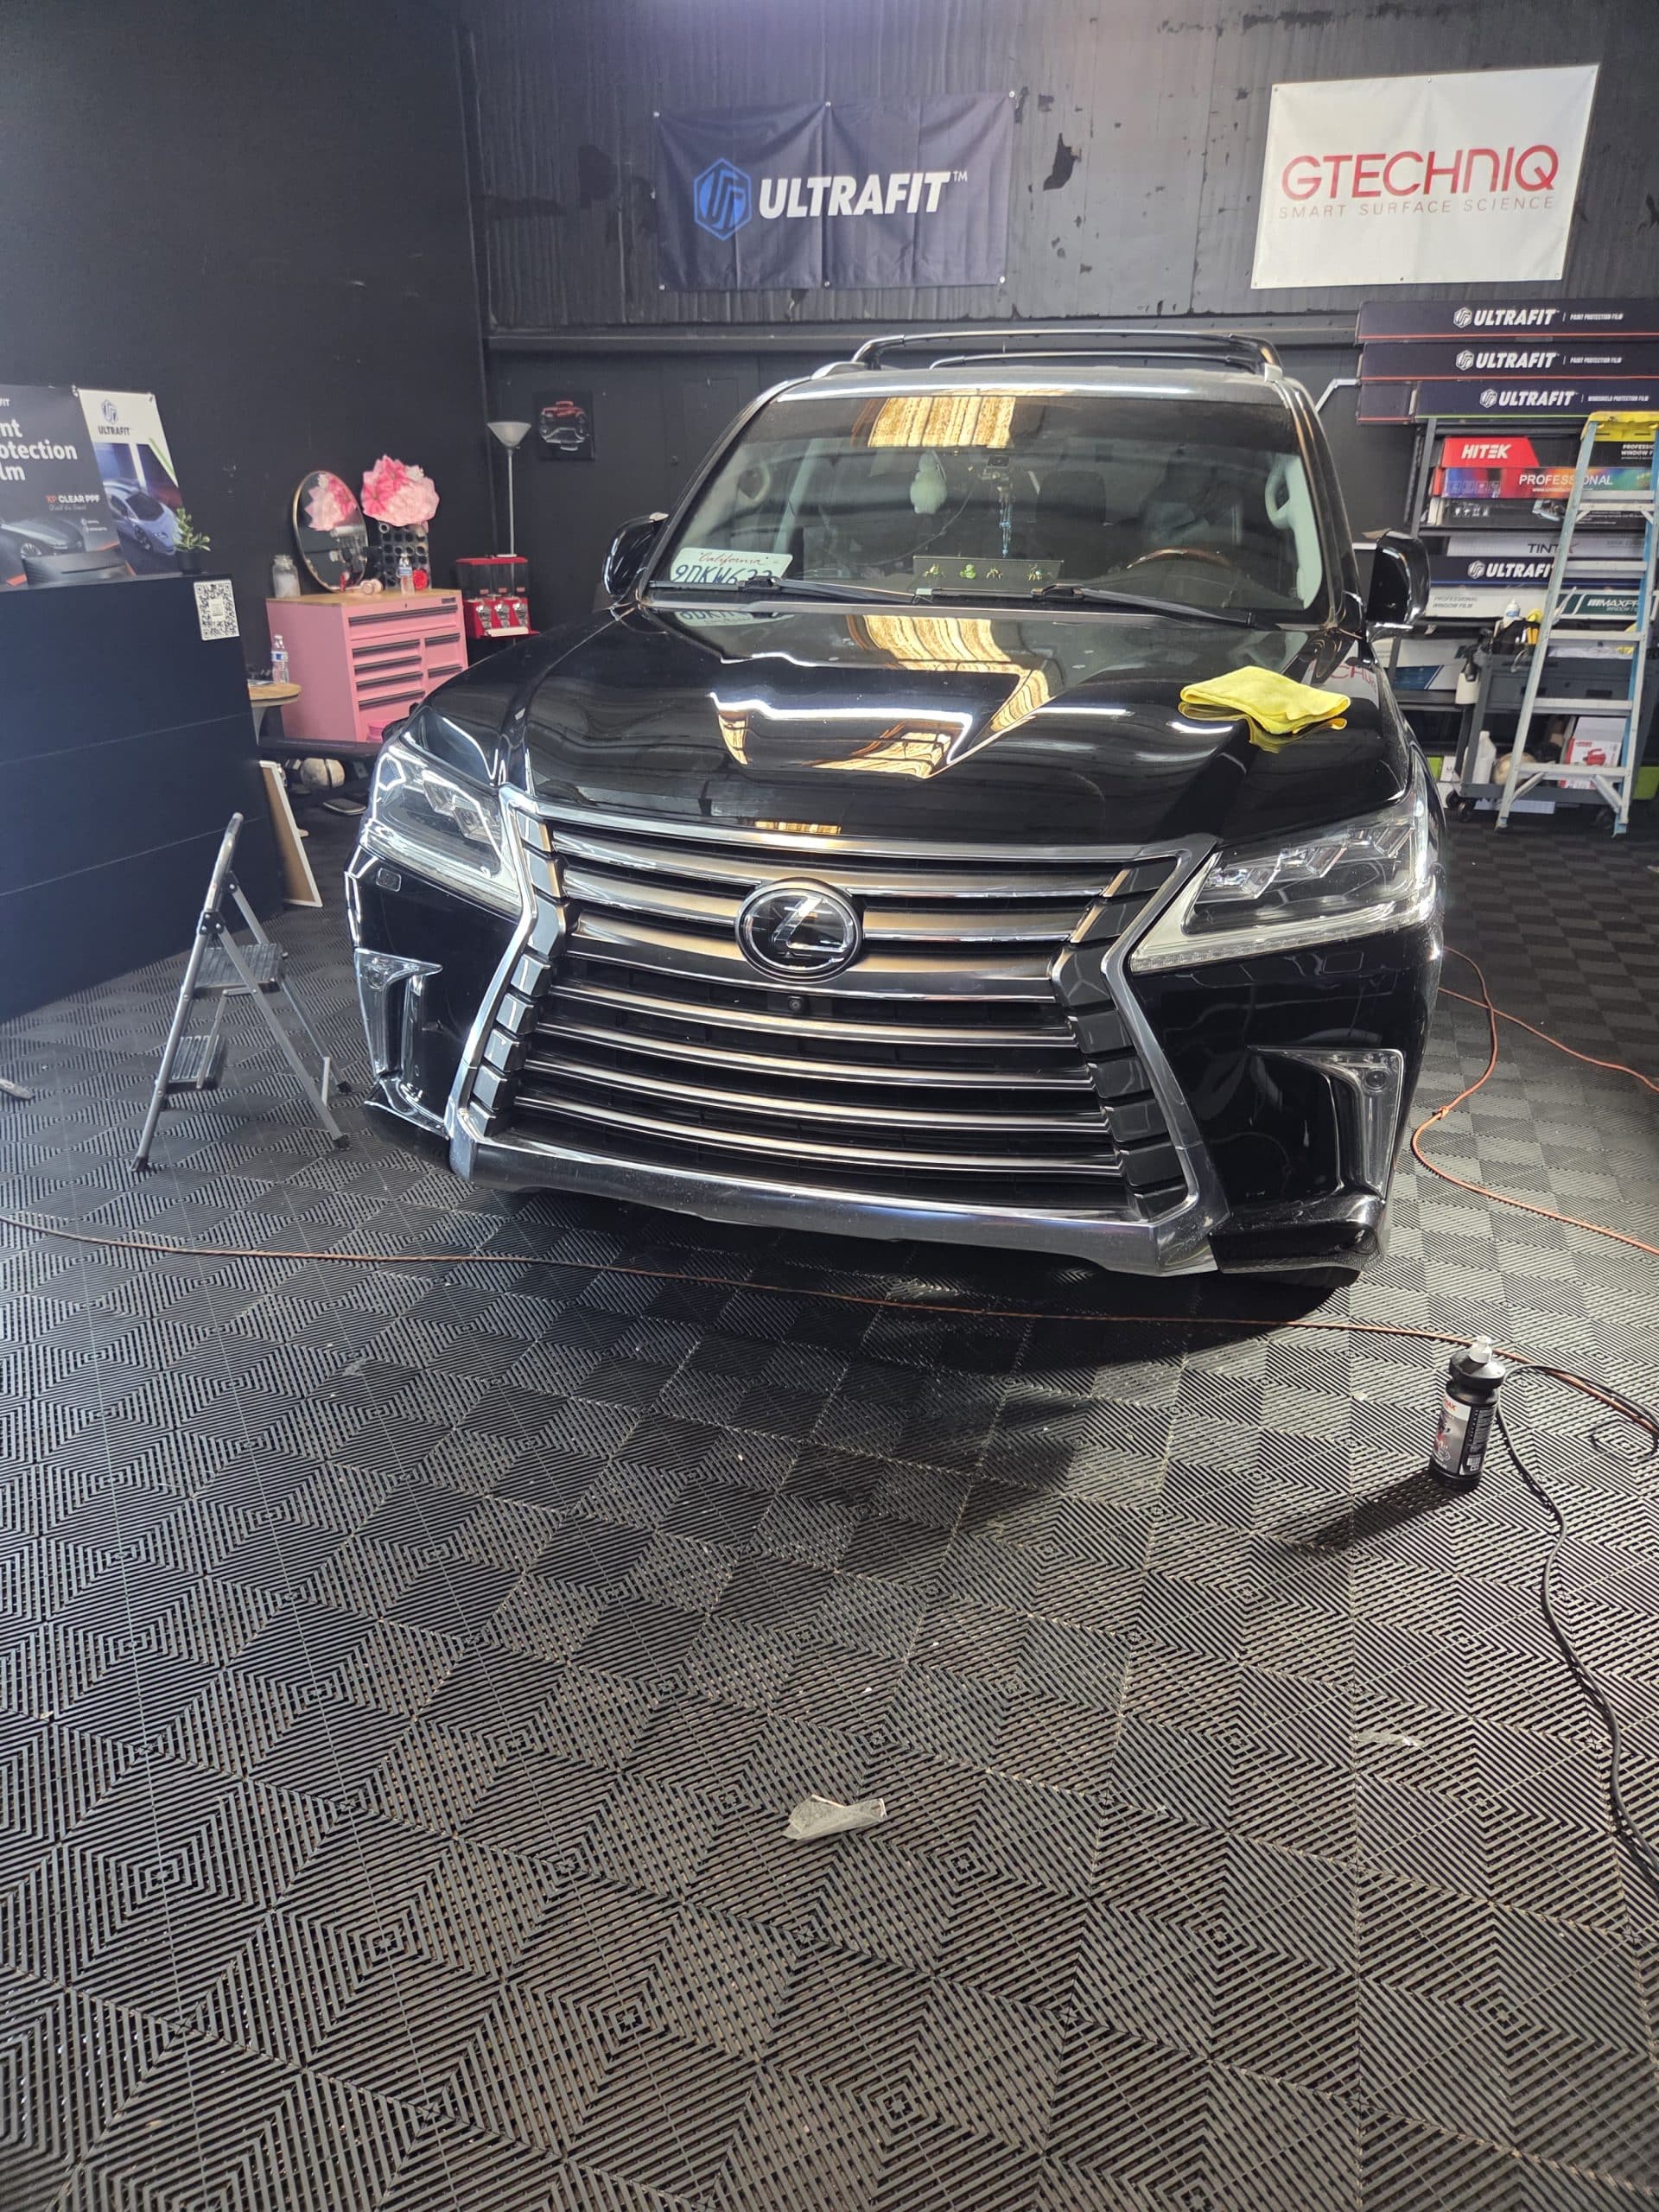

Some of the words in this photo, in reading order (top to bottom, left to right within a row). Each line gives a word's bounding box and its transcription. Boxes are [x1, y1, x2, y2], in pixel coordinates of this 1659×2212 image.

[760, 172, 951, 219] ULTRAFIT
[1279, 204, 1347, 219] SMART
[1359, 200, 1452, 216] SURFACE
[1463, 195, 1554, 213] SCIENCE
[1474, 308, 1556, 327] ULTRAFIT
[1476, 352, 1557, 369] ULTRAFIT
[1498, 391, 1575, 407] ULTRAFIT
[98, 425, 131, 436] ULTRAFIT
[1461, 443, 1512, 460] HITEK
[58, 494, 85, 504] CLEAR
[699, 551, 762, 565] California
